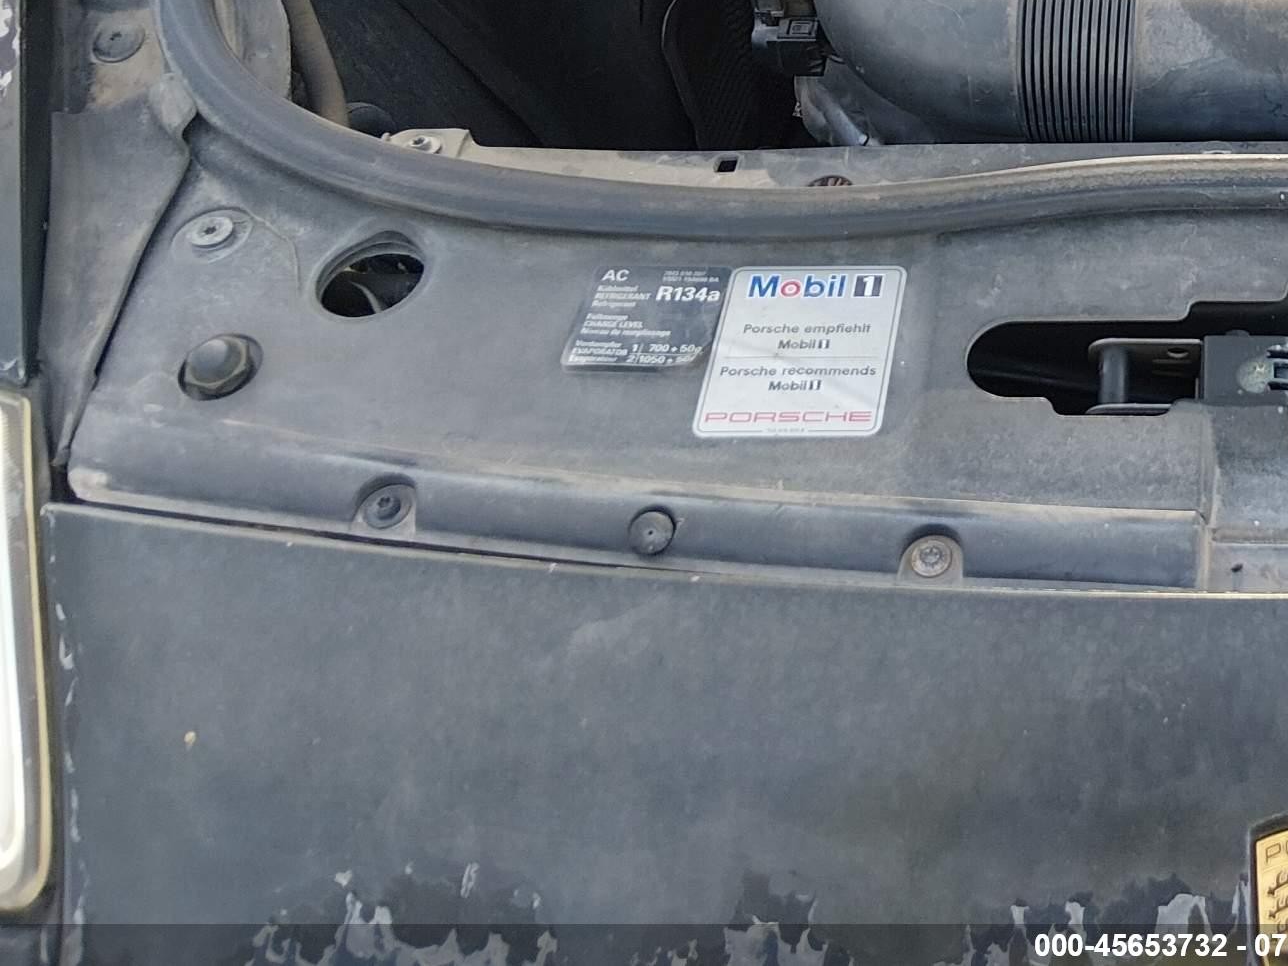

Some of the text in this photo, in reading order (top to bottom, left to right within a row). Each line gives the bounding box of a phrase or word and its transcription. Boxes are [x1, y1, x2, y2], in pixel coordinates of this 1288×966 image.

[602, 269, 629, 281] AC
[747, 275, 847, 297] Mobil
[656, 286, 721, 301] R134a
[743, 323, 871, 335] Porsche empfiehlt
[648, 344, 670, 352] 700
[778, 340, 816, 349] Mobil
[720, 365, 877, 376] Porsche recommends
[768, 381, 807, 391] Mobil
[704, 411, 873, 423] PORSCHE
